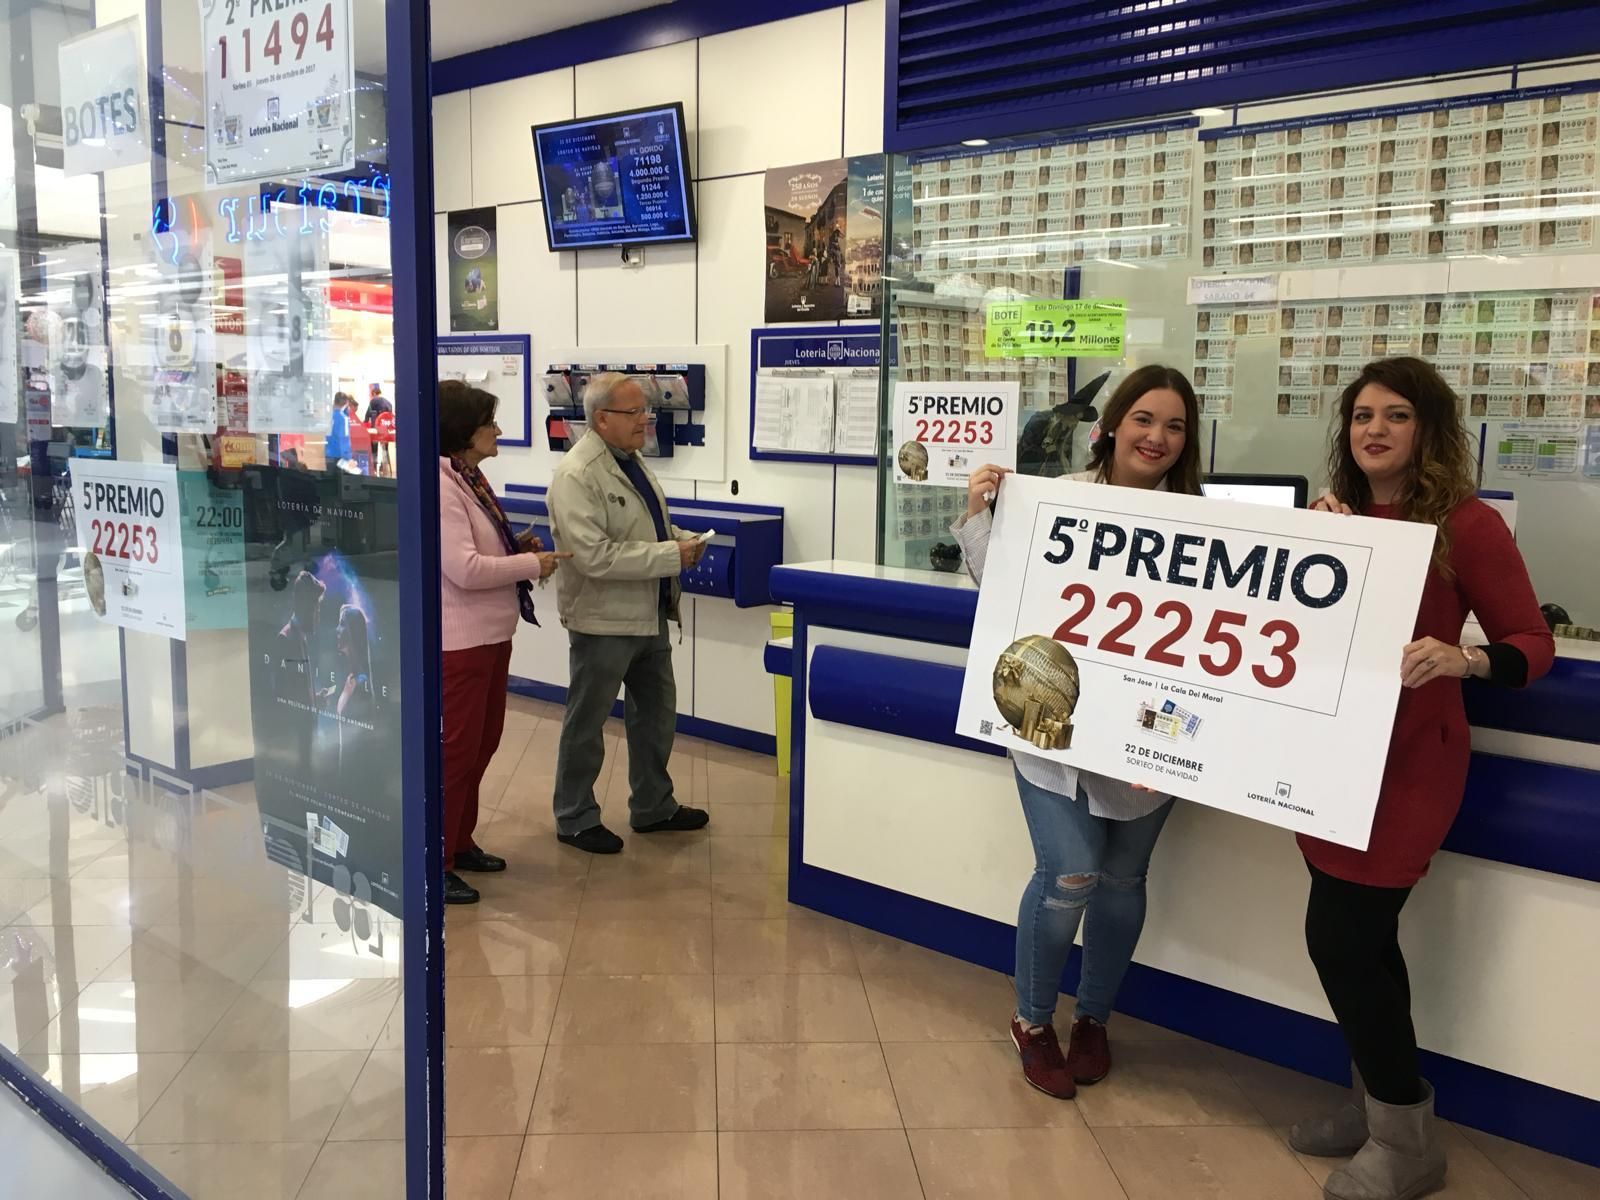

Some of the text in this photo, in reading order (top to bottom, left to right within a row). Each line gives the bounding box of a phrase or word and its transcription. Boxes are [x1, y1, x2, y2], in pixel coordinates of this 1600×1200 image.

[218, 2, 335, 79] 11494
[65, 88, 137, 146] BOTES
[272, 117, 298, 132] Nacional
[634, 154, 661, 166] 71198
[640, 145, 664, 154] GORDO
[664, 165, 670, 173] €
[994, 310, 1018, 320] BOTE
[1025, 320, 1120, 347] 19,2 Millones
[844, 346, 880, 357] Naciona
[908, 396, 1003, 415] 5º PREMIO
[916, 419, 993, 444] 22253
[94, 483, 164, 518] PREMIO
[312, 506, 322, 514] DE
[327, 508, 364, 520] NAVIDAD
[197, 506, 242, 527] 22:00
[92, 519, 158, 564] 22253
[1043, 515, 1348, 609] 5º PREMIO
[1052, 583, 1300, 688] 22253
[1123, 674, 1135, 683] San
[1138, 678, 1152, 686] Jose
[1171, 686, 1186, 694] Cala
[1189, 690, 1200, 698] Del
[1202, 693, 1223, 703] Moral
[1125, 744, 1204, 772] 22 DE DICIEMBRE
[1126, 757, 1199, 782] SORTEO DE NAVIDAD
[1247, 792, 1314, 816] LOTERÍA NACIONAL
